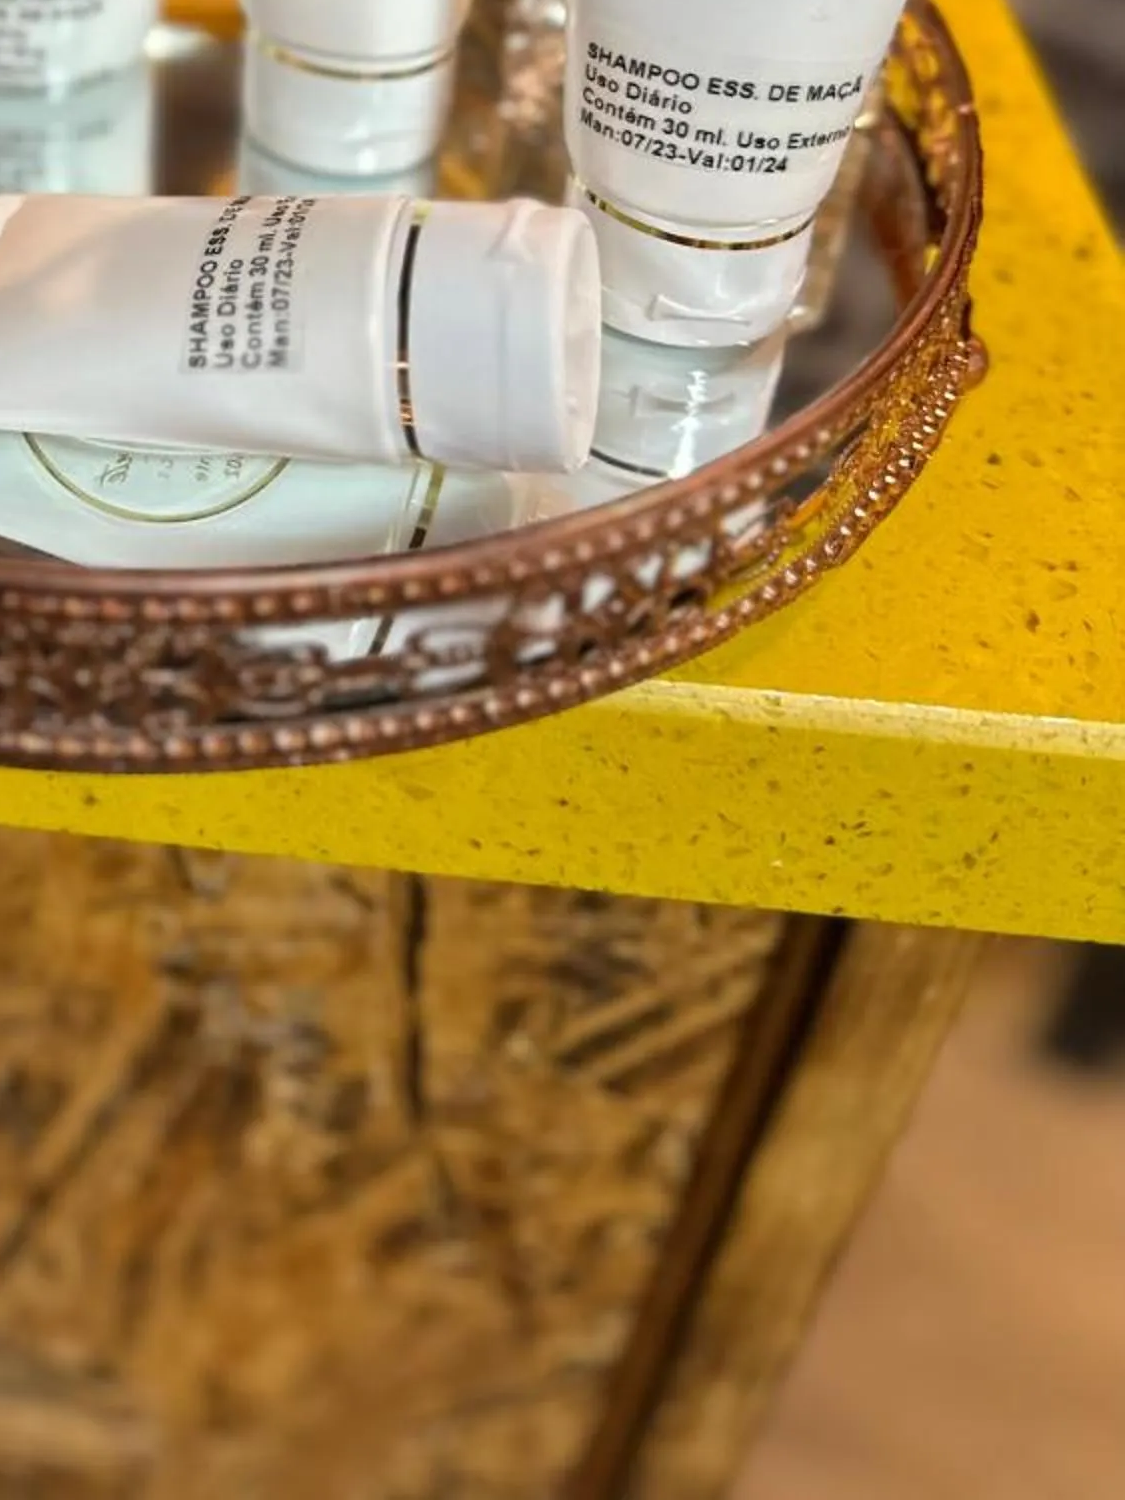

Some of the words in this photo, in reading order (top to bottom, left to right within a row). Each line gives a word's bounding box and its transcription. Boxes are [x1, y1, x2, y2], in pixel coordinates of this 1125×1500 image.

[584, 64, 620, 94] Uso
[626, 82, 692, 115] Diário
[586, 41, 700, 90] SHAMPOO
[707, 76, 759, 101] ESS.
[768, 84, 801, 103] DE
[580, 108, 789, 173] Man:07/23-Val:01/24
[582, 87, 656, 131] Contém
[662, 117, 689, 139] 30
[695, 128, 728, 147] ml.
[737, 131, 780, 150] Uso
[188, 259, 217, 369] SHAMPOO
[204, 222, 233, 257] ESS.
[249, 255, 270, 278] 30
[214, 325, 235, 369] Uso
